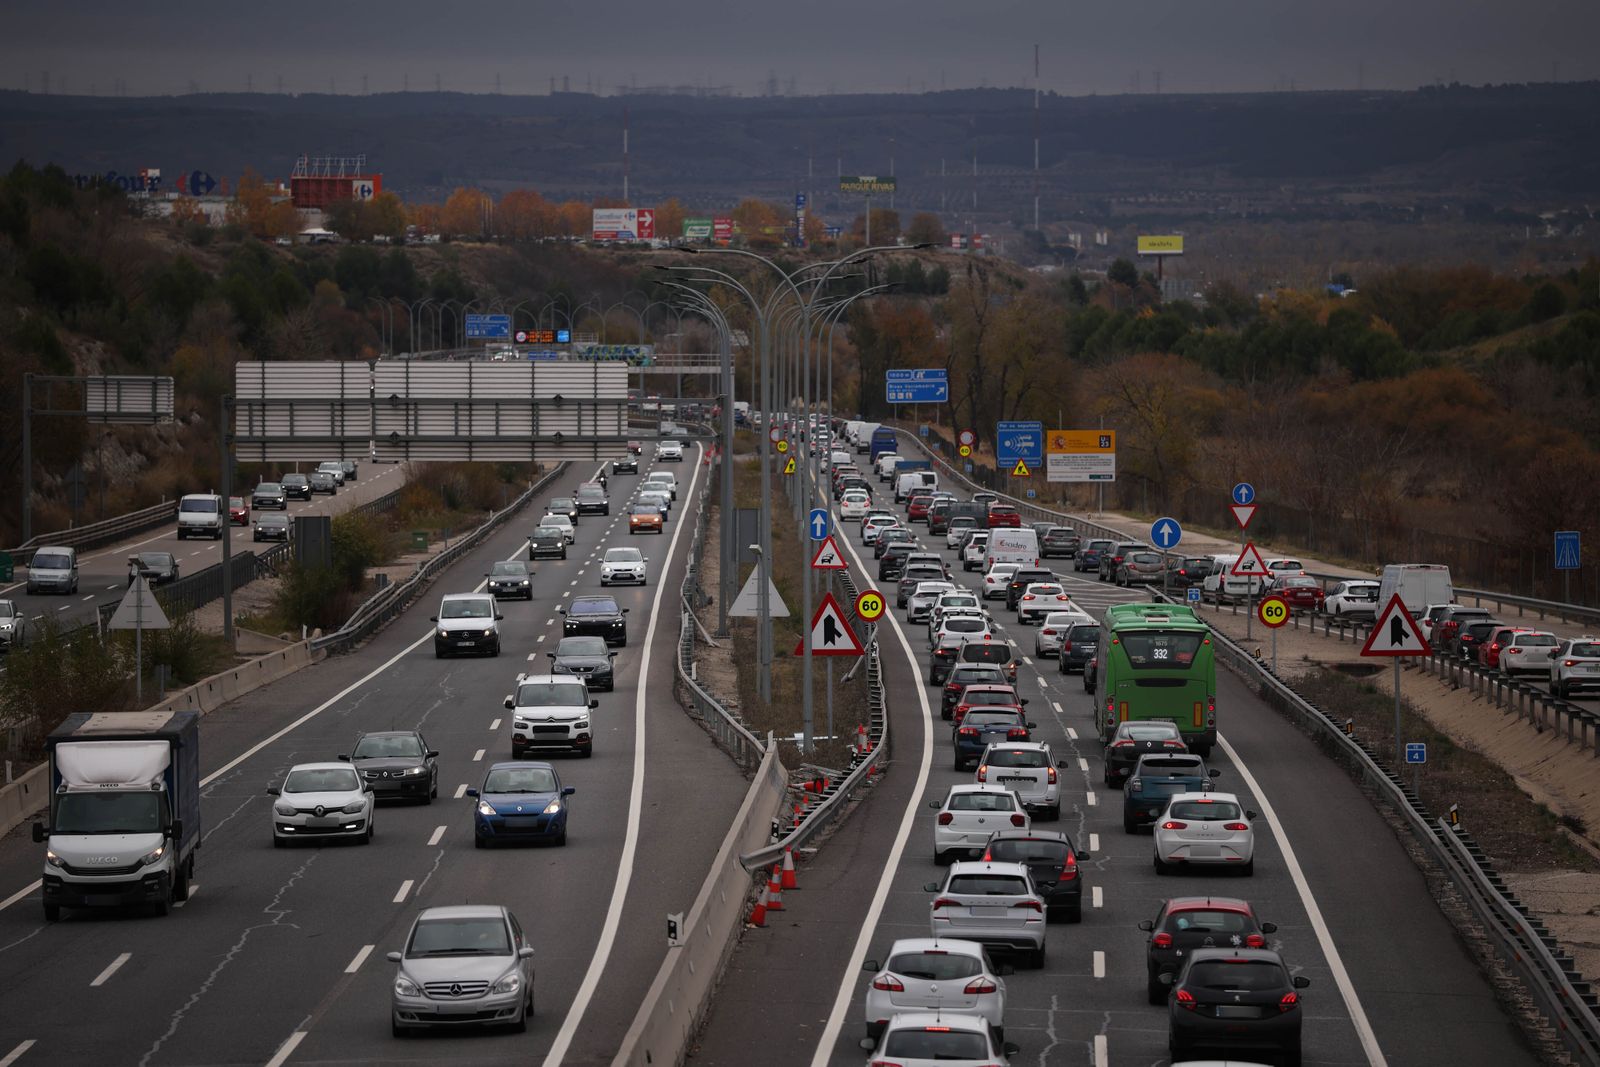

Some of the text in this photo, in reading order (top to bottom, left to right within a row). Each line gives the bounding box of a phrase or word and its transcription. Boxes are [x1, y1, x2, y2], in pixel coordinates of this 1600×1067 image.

[840, 182, 896, 192] PARQUE RIVAS
[862, 600, 878, 611] 60
[1266, 606, 1283, 617] 60
[1153, 648, 1168, 659] 332
[1412, 752, 1419, 760] 4
